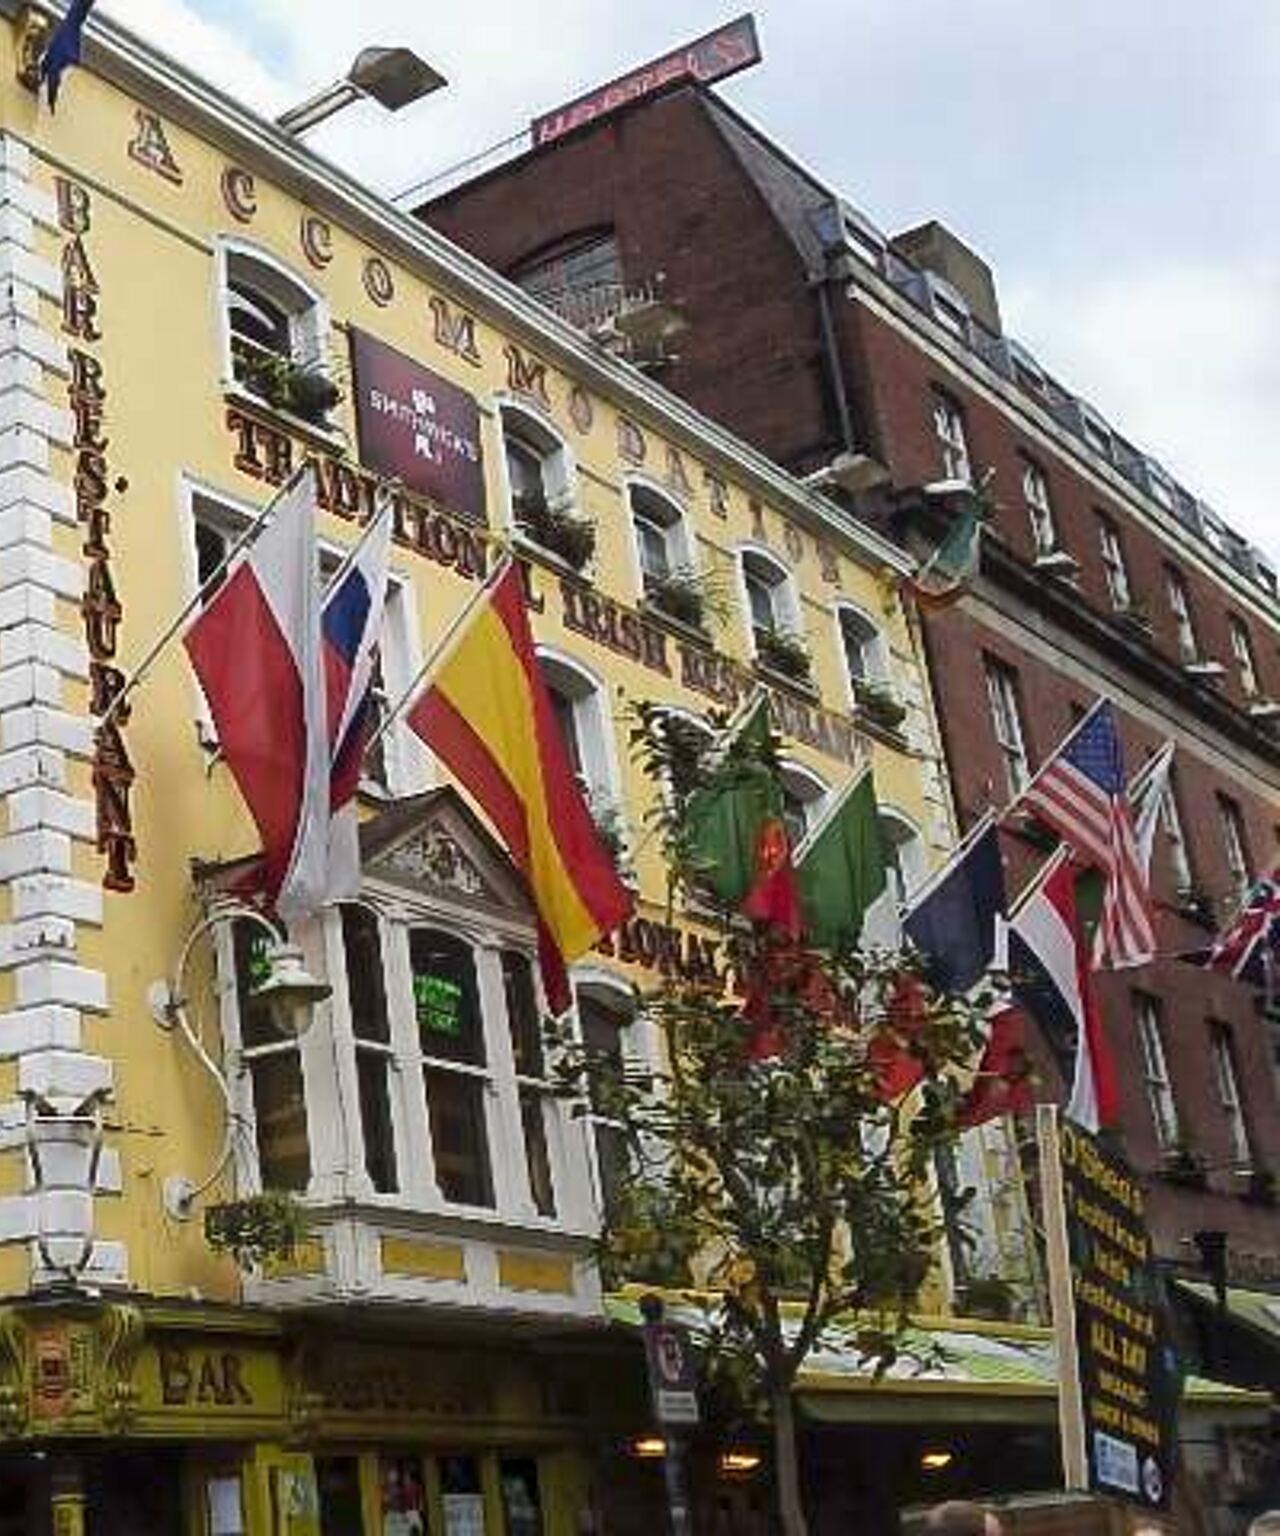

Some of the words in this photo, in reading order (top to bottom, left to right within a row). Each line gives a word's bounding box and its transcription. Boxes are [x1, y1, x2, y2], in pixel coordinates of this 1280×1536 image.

[55, 176, 102, 343] BAR
[227, 408, 545, 614] TRDITIONL
[67, 348, 137, 893] RESTAURANT
[159, 1345, 252, 1405] BAR
